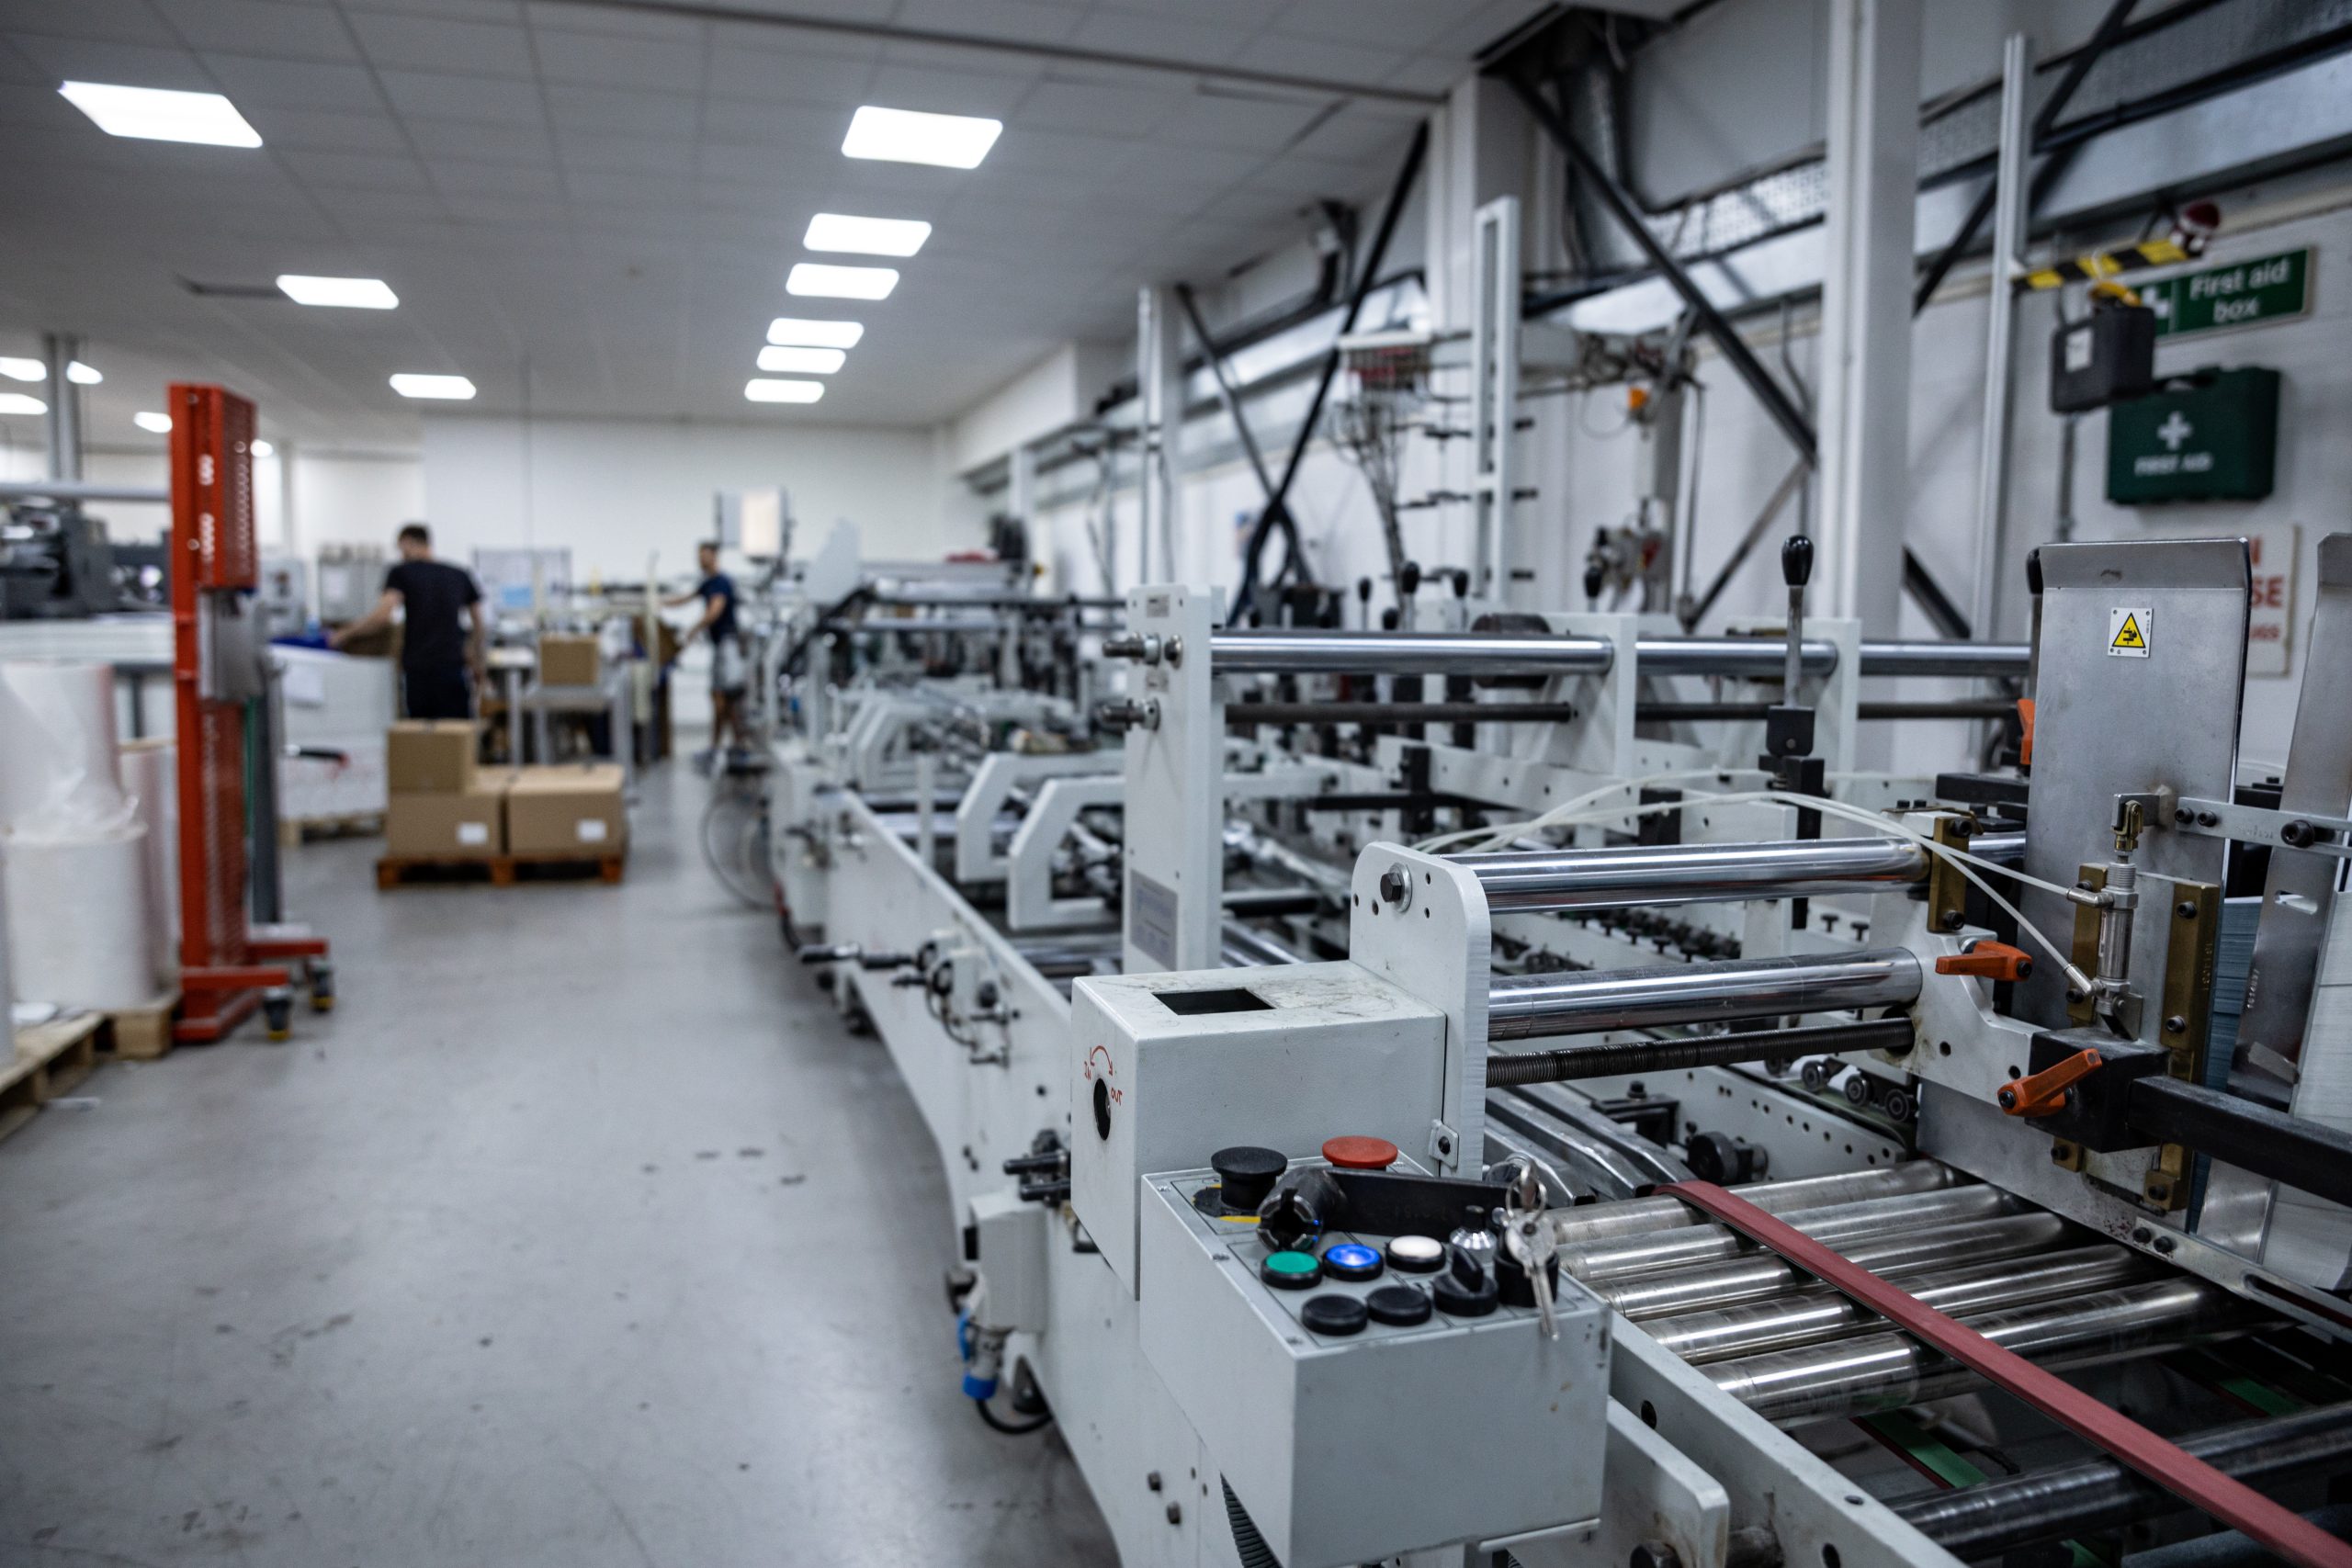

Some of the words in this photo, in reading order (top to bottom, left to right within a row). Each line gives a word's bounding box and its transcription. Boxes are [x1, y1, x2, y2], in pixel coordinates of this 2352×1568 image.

[2189, 266, 2245, 301] First
[2248, 257, 2290, 289] aid
[2213, 296, 2260, 323] box
[1084, 1061, 1091, 1080] IN
[1111, 1088, 1123, 1106] OUT
